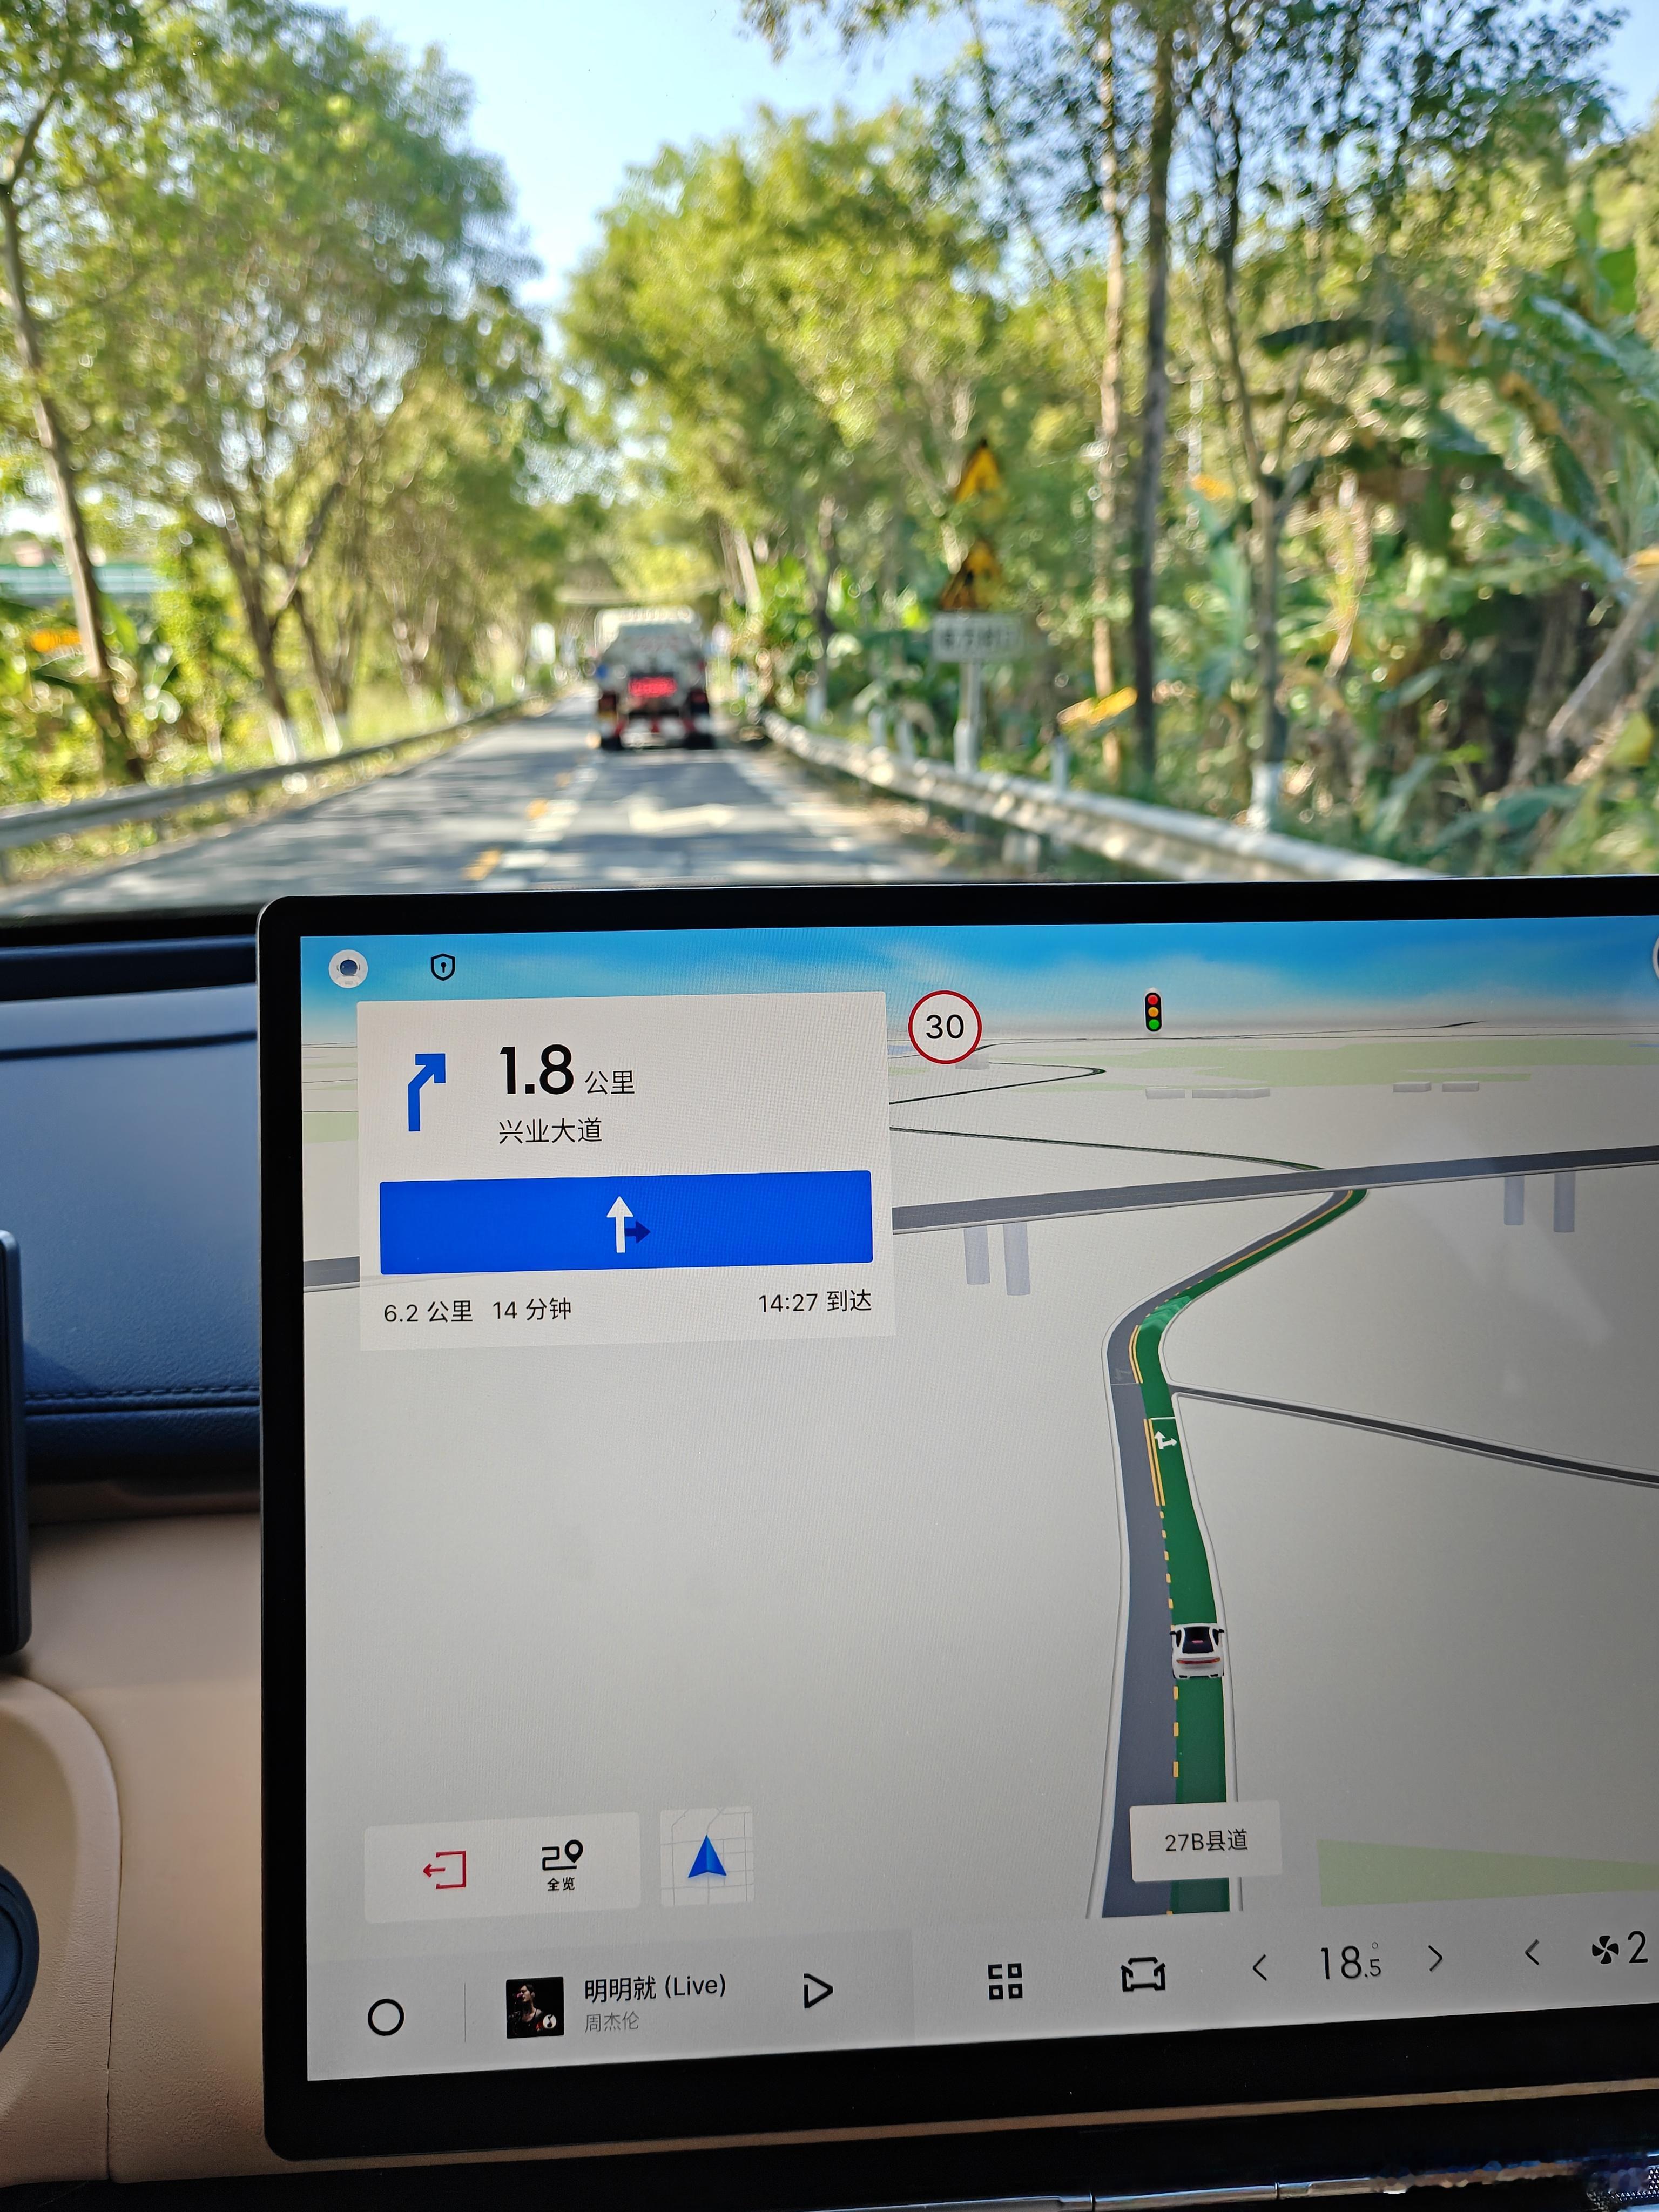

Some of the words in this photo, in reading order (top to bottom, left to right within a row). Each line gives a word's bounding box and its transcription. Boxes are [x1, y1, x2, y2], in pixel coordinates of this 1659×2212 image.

[926, 1014, 964, 1040] 30
[499, 1044, 574, 1095] 1.8
[584, 1070, 635, 1095] 公里
[499, 1117, 603, 1144] 兴业大道
[384, 1304, 419, 1323] 6.2
[427, 1300, 473, 1323] 公里
[493, 1301, 518, 1319] 14
[525, 1297, 572, 1321] 分钟
[759, 1293, 818, 1313] 14:27
[826, 1289, 872, 1312] 到达
[1165, 1828, 1248, 1852] 27B县道
[547, 1877, 576, 1891] 全览
[1628, 1931, 1648, 1964] 2
[585, 1975, 657, 2004] 明明就
[665, 1973, 726, 1999] (Live)
[585, 2011, 640, 2033] 周杰伦
